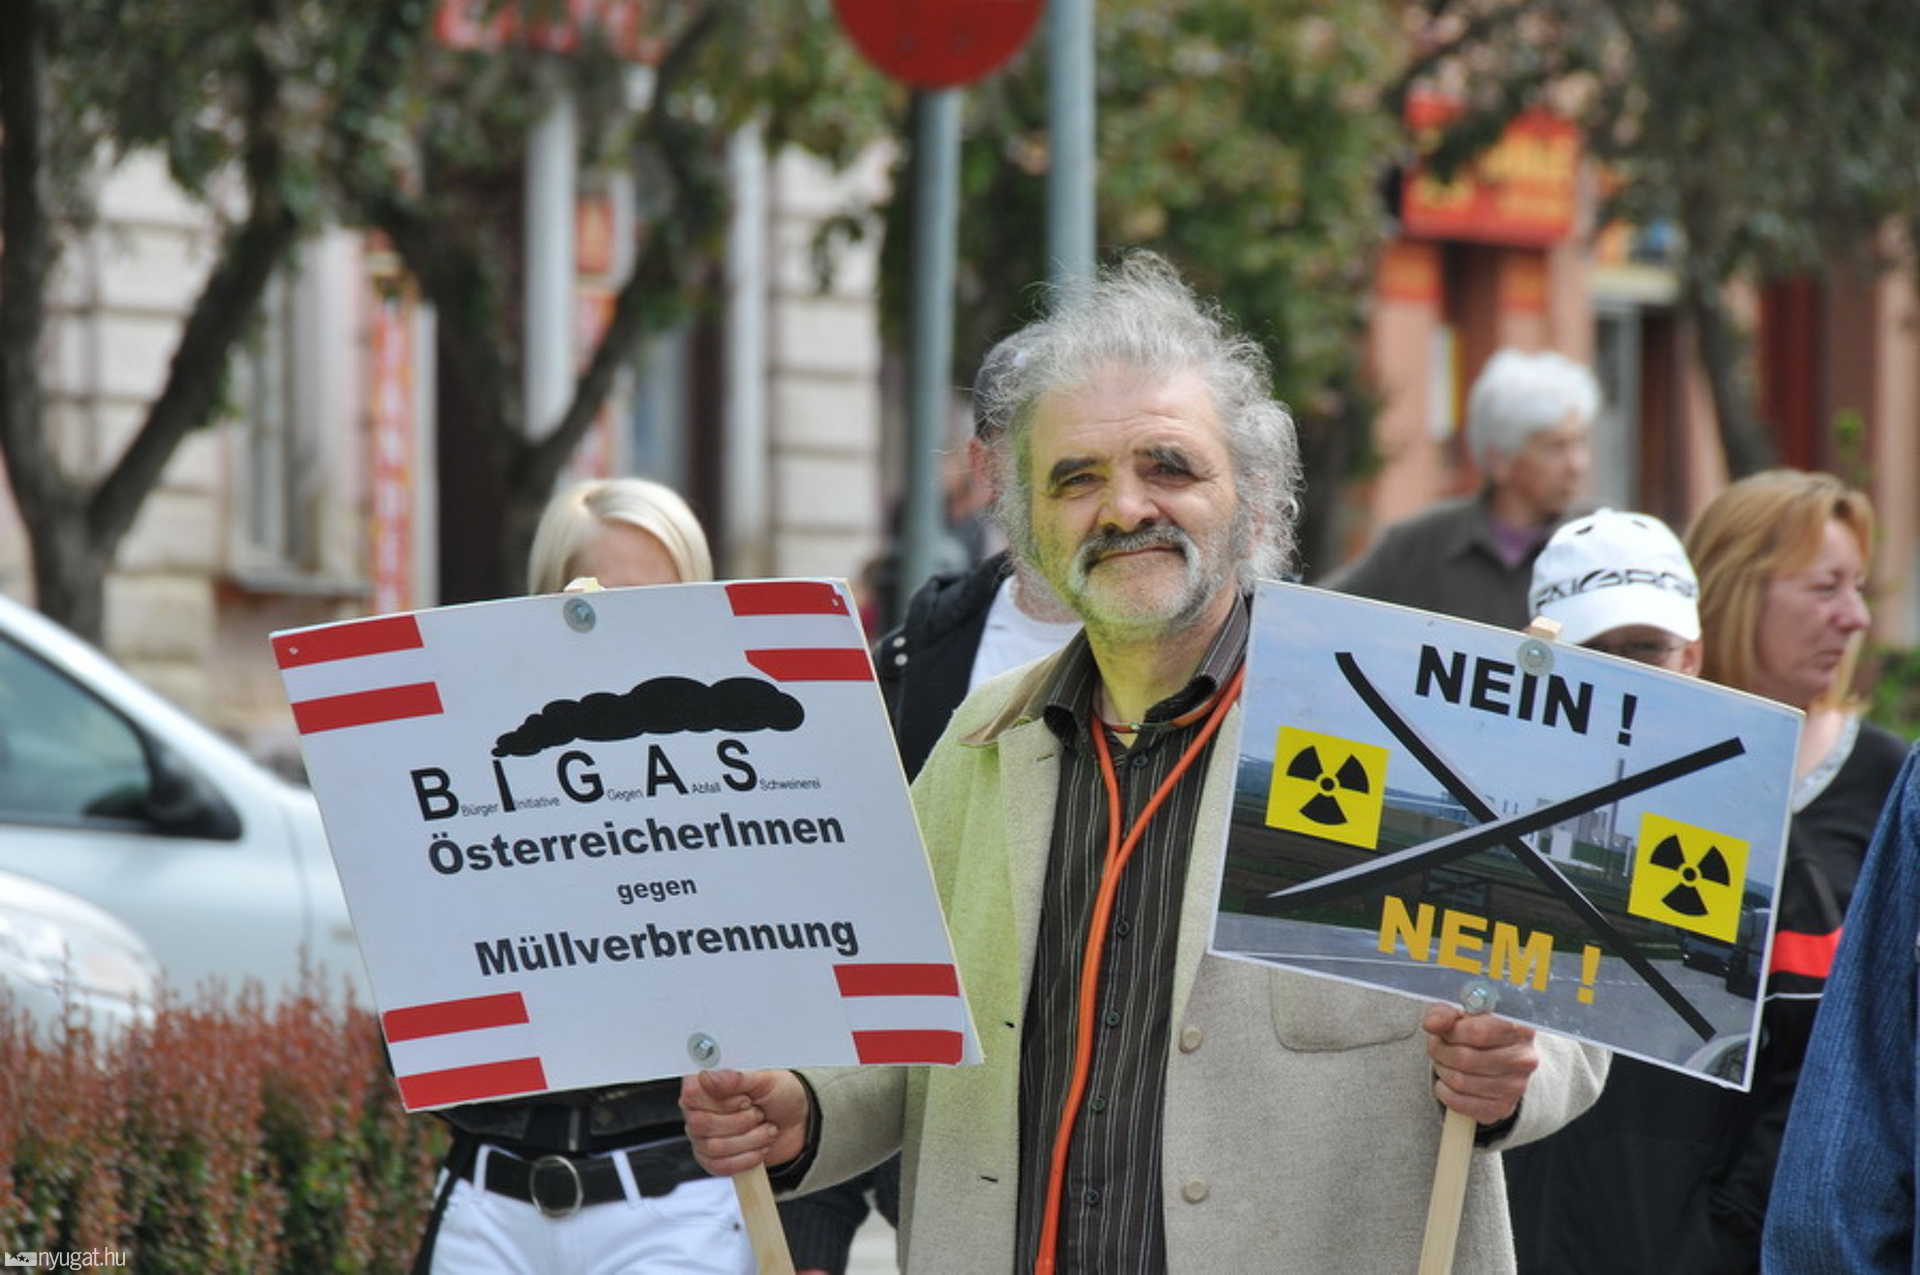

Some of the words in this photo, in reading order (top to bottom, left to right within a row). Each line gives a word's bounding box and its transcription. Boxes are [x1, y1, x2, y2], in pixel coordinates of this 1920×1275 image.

[1415, 644, 1594, 736] NEIN
[461, 802, 499, 817] Bürger
[606, 786, 644, 803] Gegen
[691, 781, 722, 794] Abfall
[759, 776, 821, 791] Schweinerei
[428, 812, 846, 875] ÖsterreicherInnen
[616, 876, 698, 905] gegen
[474, 920, 860, 976] Müllverbrennung
[1377, 895, 1554, 992] NEM
